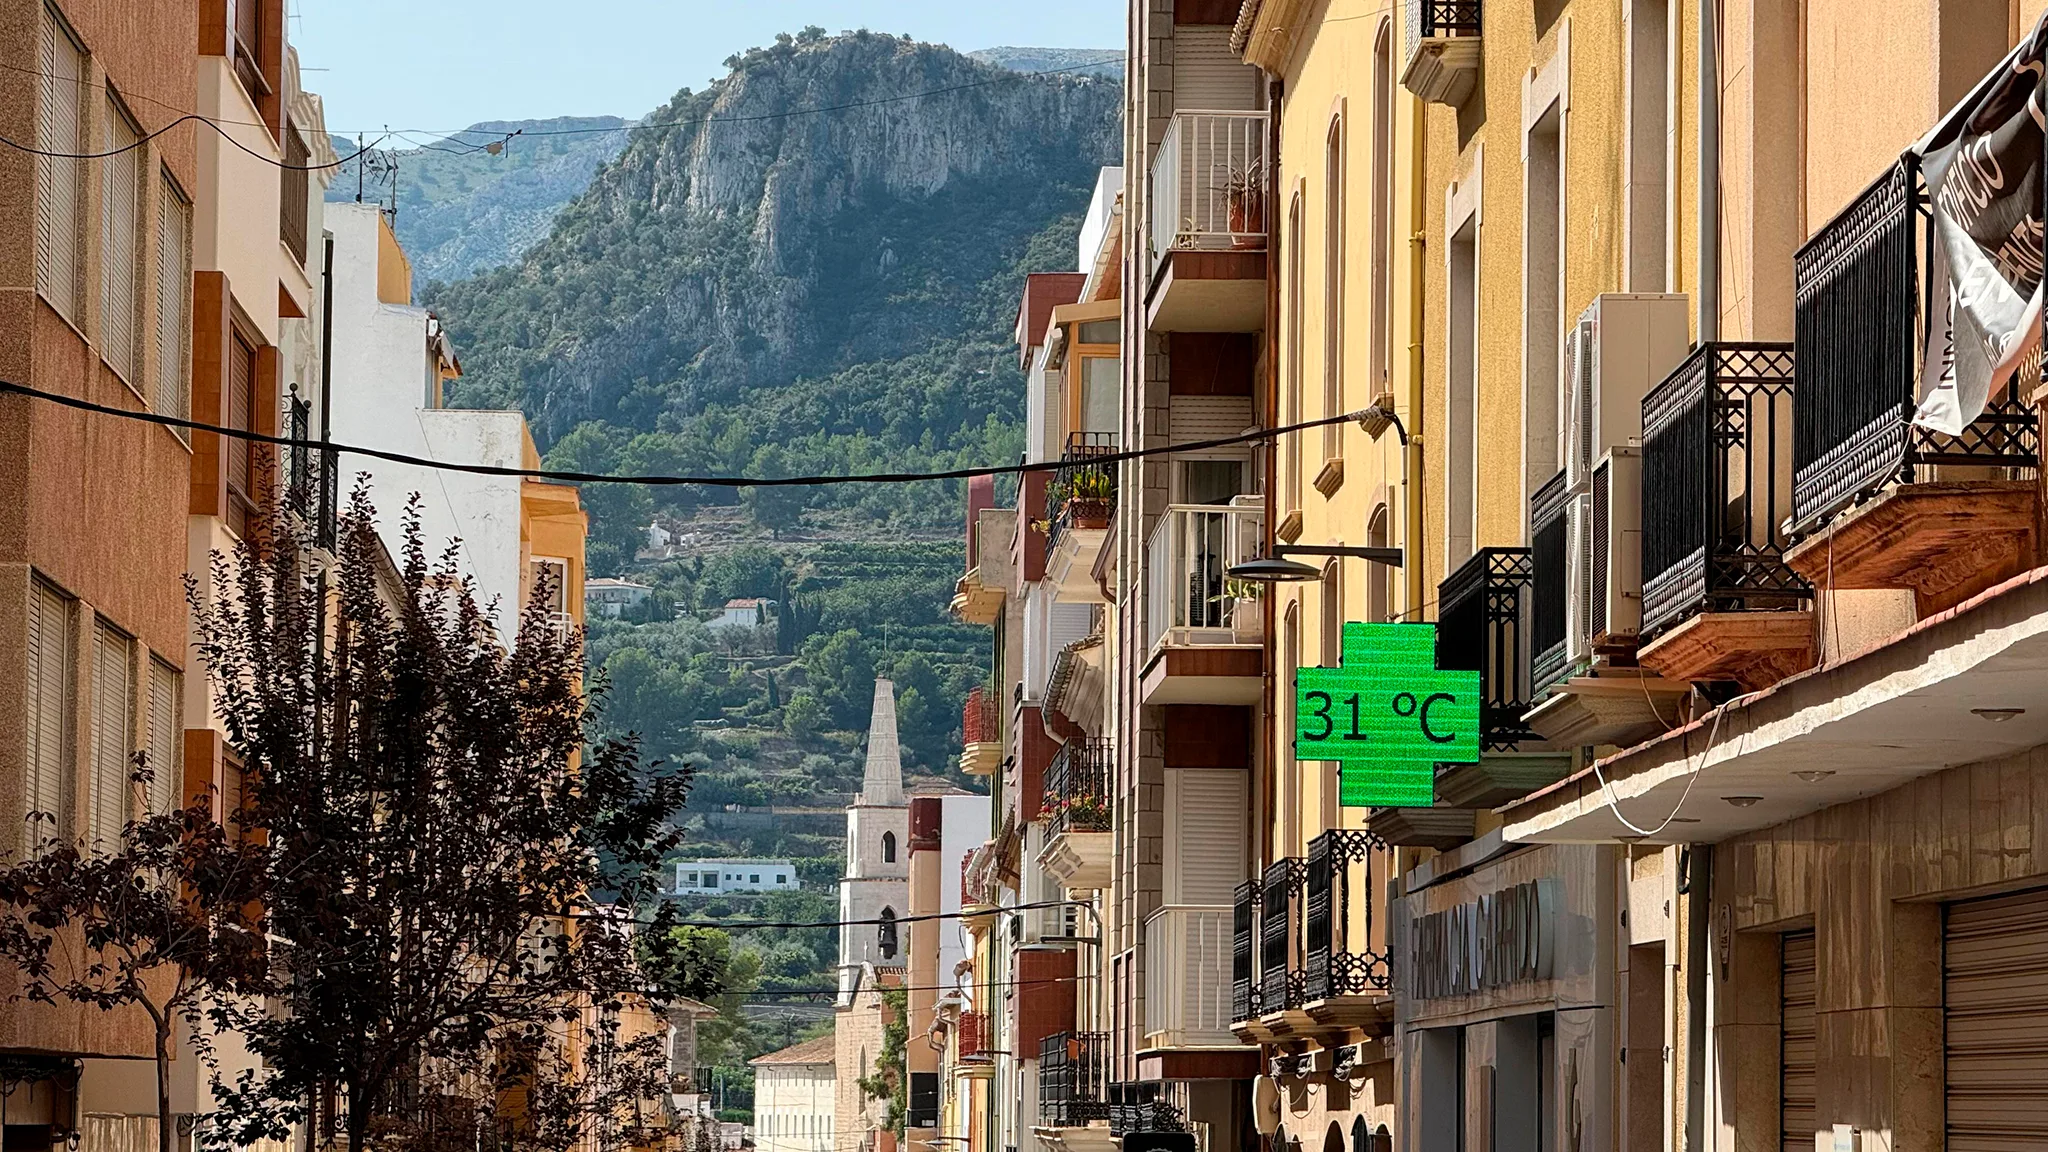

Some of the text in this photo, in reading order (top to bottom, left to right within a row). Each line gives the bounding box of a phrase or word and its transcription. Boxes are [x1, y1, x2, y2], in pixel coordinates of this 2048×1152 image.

[1303, 691, 1367, 741] 31
[1412, 879, 1541, 1000] FARMACIA GARRIDO
